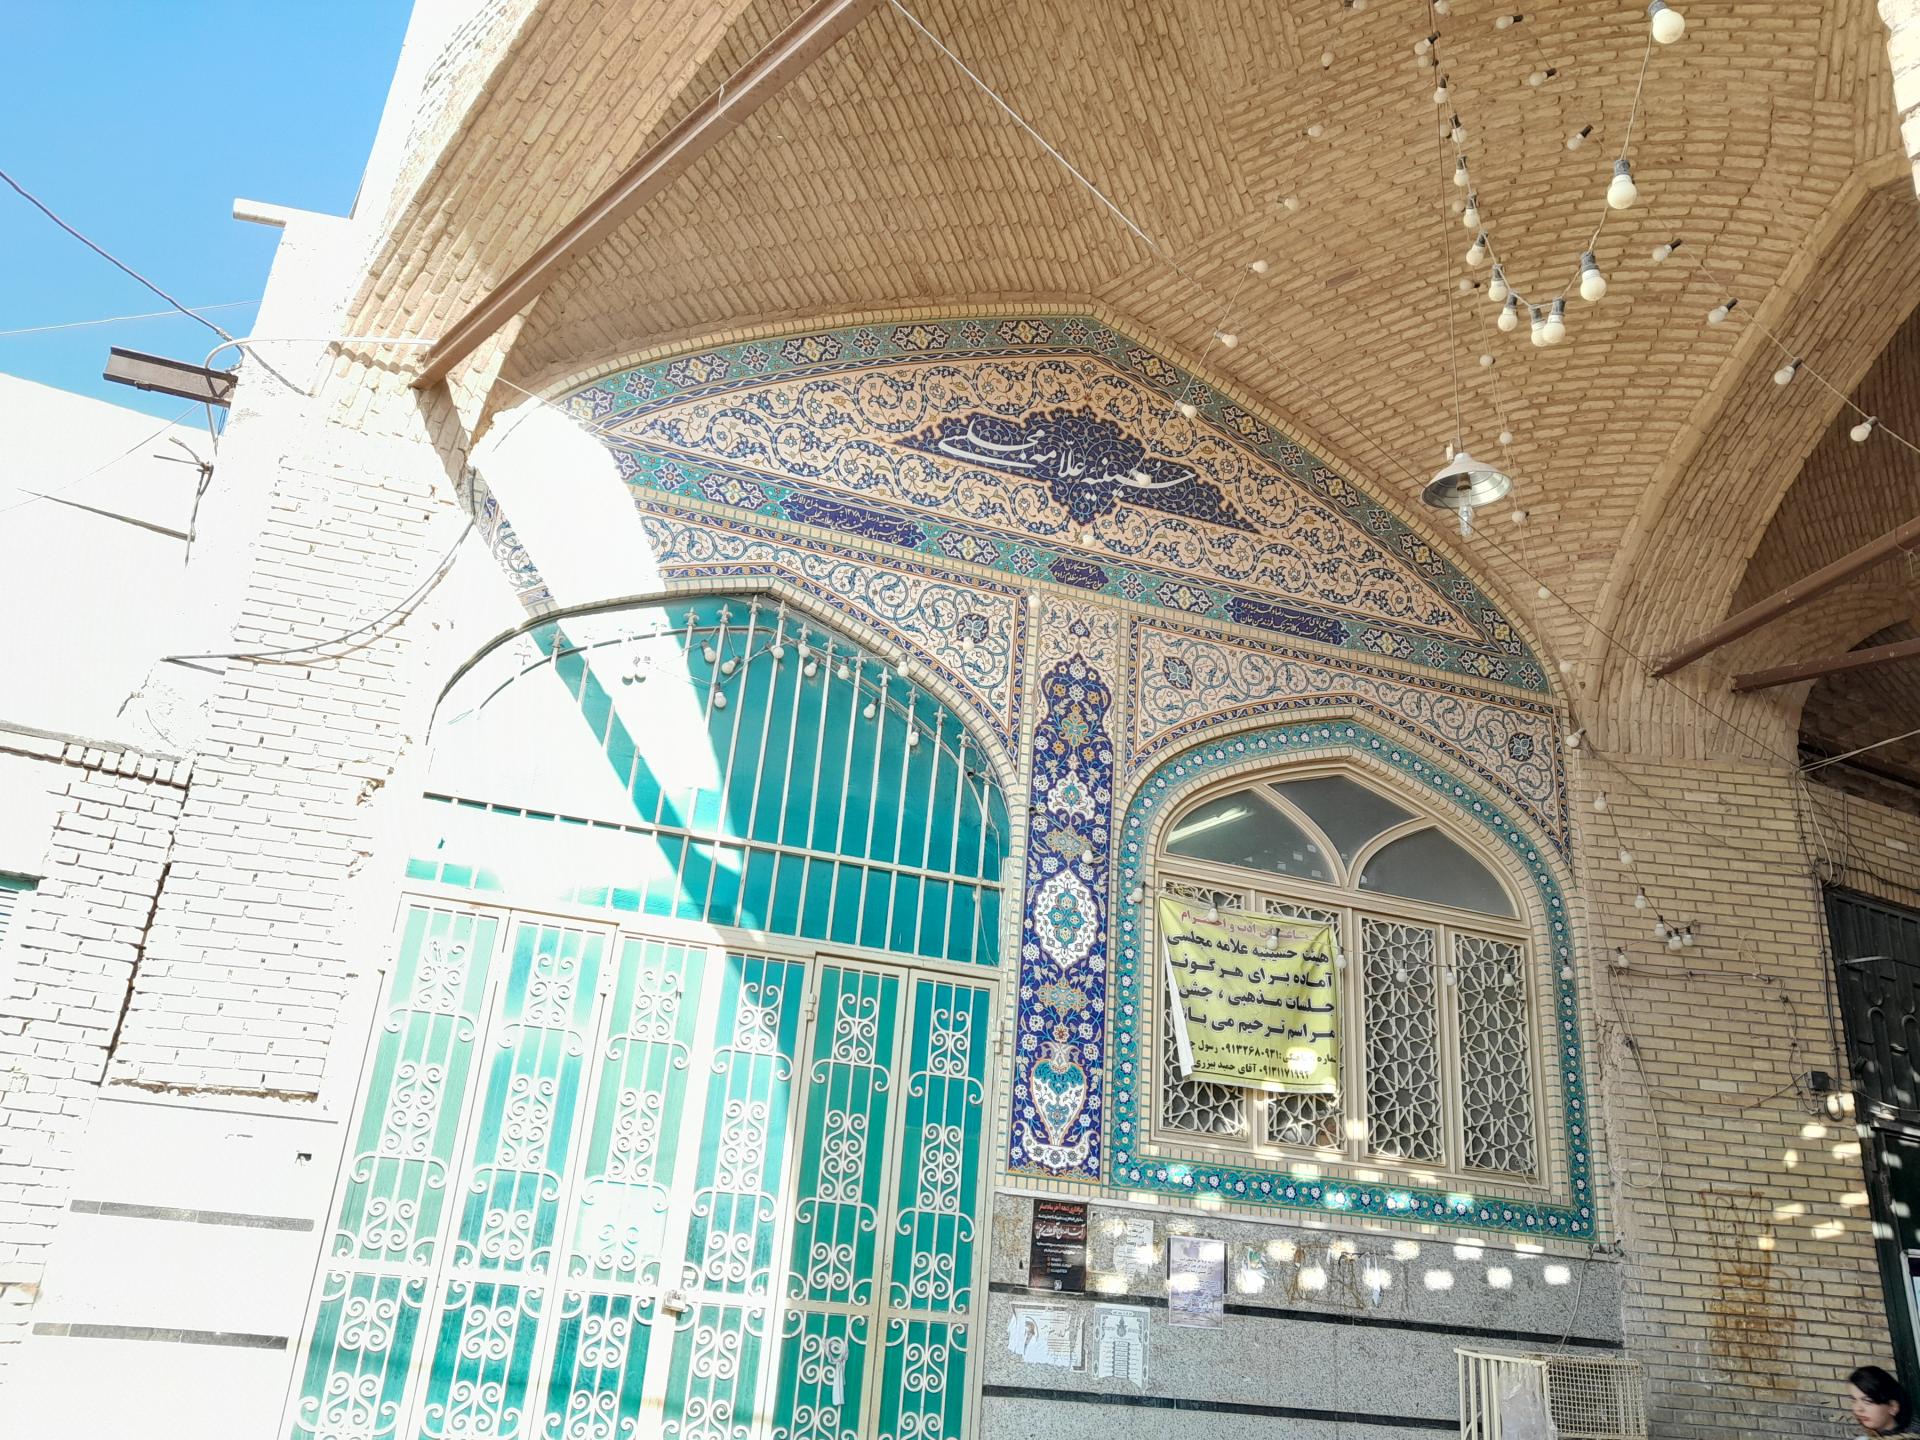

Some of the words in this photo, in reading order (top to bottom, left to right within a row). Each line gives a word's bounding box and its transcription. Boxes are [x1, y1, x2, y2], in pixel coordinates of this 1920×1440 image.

[937, 416, 1046, 469] مجلسی
[1229, 922, 1235, 933] و
[1167, 930, 1213, 950] مجلسی
[1216, 937, 1249, 956] علامه
[1252, 946, 1298, 962] حسینیه
[1302, 949, 1329, 967] هیئت
[1218, 966, 1244, 979] هر
[1248, 967, 1290, 986] برای
[1293, 971, 1333, 988] آماده
[1178, 981, 1213, 1002] جشن
[1285, 994, 1335, 1018] جلسات
[1211, 1017, 1235, 1032] می
[1238, 1019, 1286, 1038] ترحیم
[1287, 1023, 1336, 1044] مراسم
[1197, 1039, 1219, 1054] رسول
[1217, 1061, 1236, 1072] حمید
[1237, 1063, 1257, 1075] آقای
